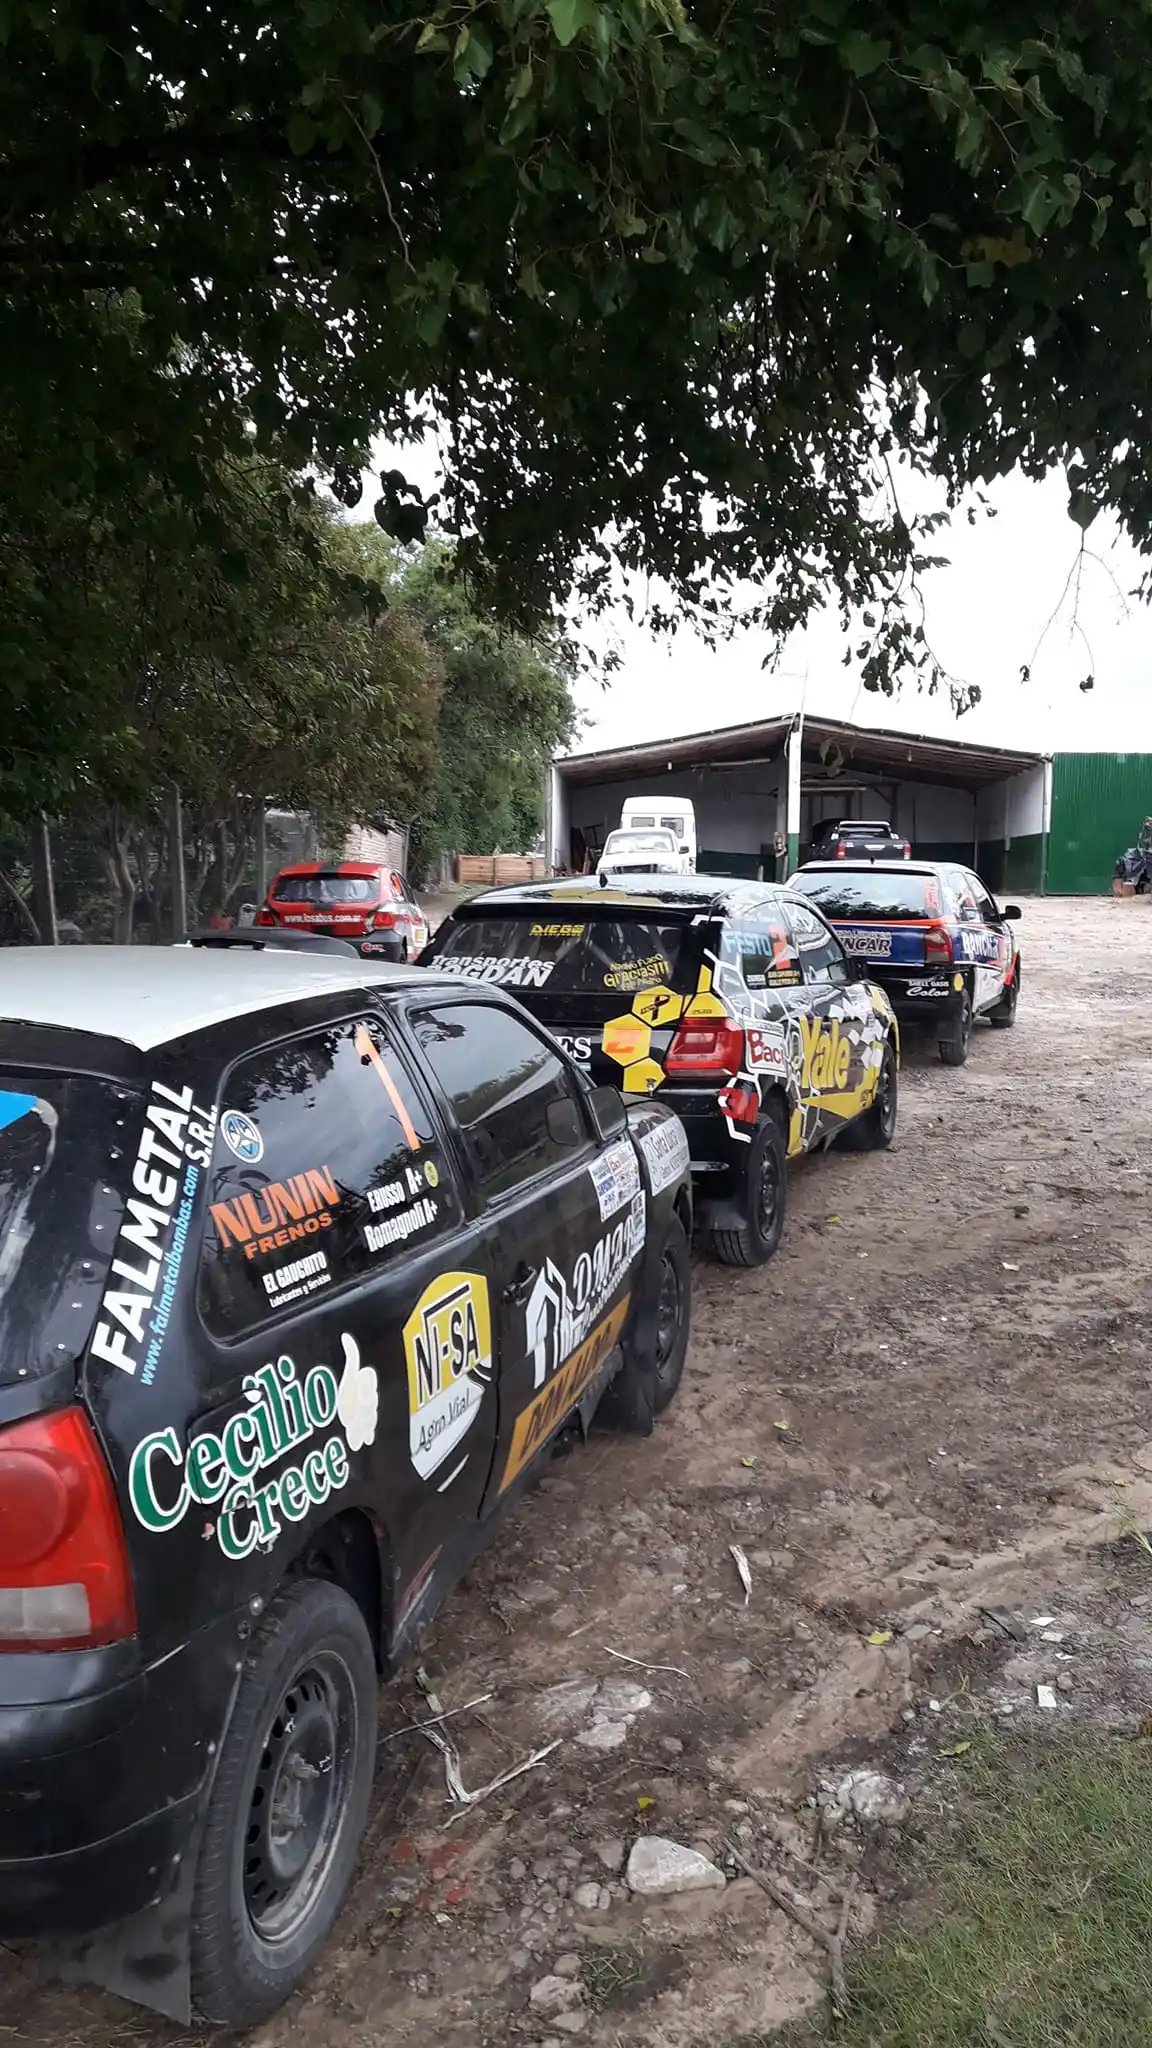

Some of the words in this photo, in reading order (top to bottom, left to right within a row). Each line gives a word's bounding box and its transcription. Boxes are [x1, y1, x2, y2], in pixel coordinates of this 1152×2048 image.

[432, 955, 556, 970] Transportes
[801, 1016, 851, 1089] Yale
[208, 1164, 342, 1249] NUNIN
[405, 1167, 423, 1196] A+
[91, 1081, 194, 1376] FALMETAL
[243, 1212, 333, 1260] FRENOS
[363, 1202, 428, 1252] Romagnoli
[423, 1198, 439, 1224] A+
[140, 1164, 200, 1387] www.falmetalbombas.com
[262, 1273, 280, 1295] EL
[275, 1250, 328, 1291] GAUCHITO
[128, 1354, 338, 1532] Cecilio
[418, 1413, 448, 1453] Agro
[448, 1386, 472, 1423] Vial
[216, 1436, 350, 1560] Crece
